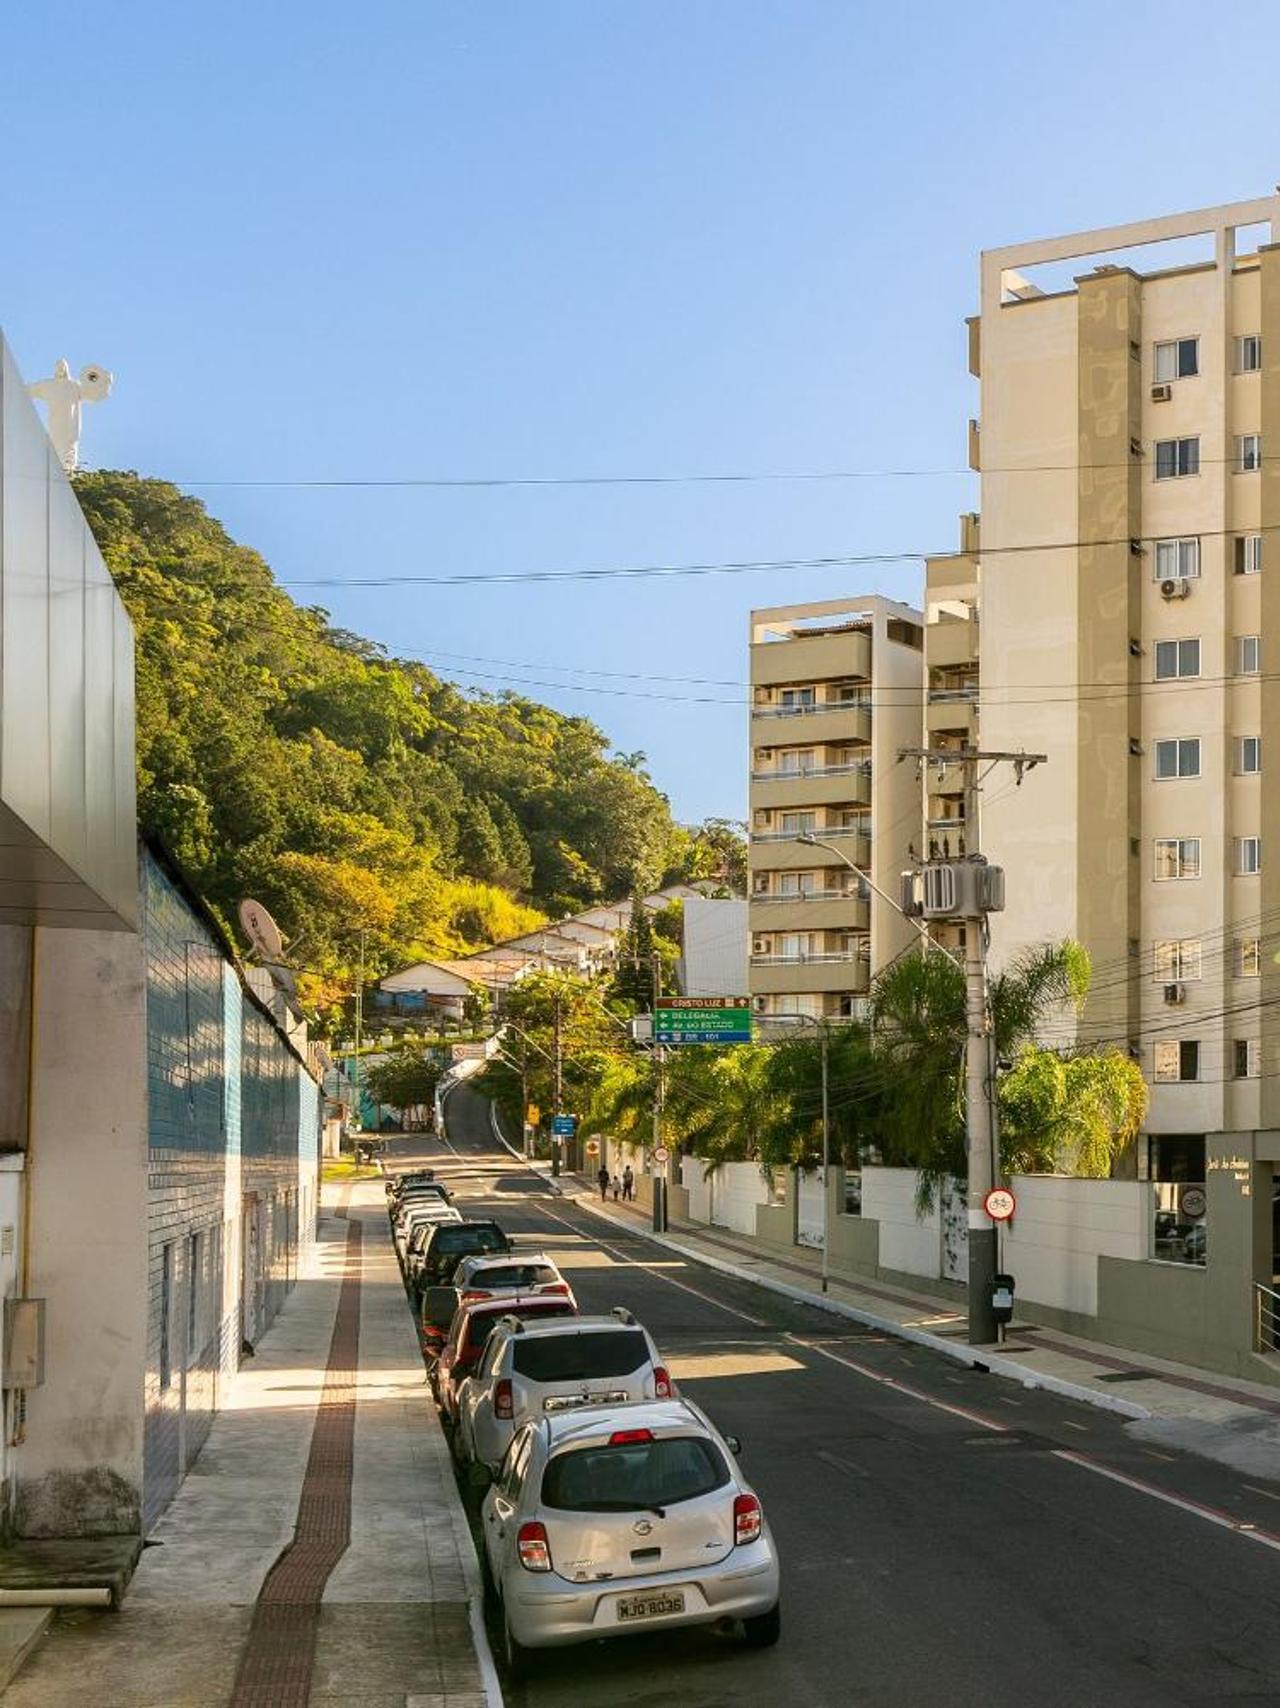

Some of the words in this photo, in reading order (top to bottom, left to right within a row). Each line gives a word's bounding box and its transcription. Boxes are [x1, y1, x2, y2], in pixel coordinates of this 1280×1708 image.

[671, 999, 703, 1007] CRISTO
[705, 999, 721, 1007] LUZ
[700, 1021, 734, 1029] ESTADO
[705, 1033, 720, 1041] 101
